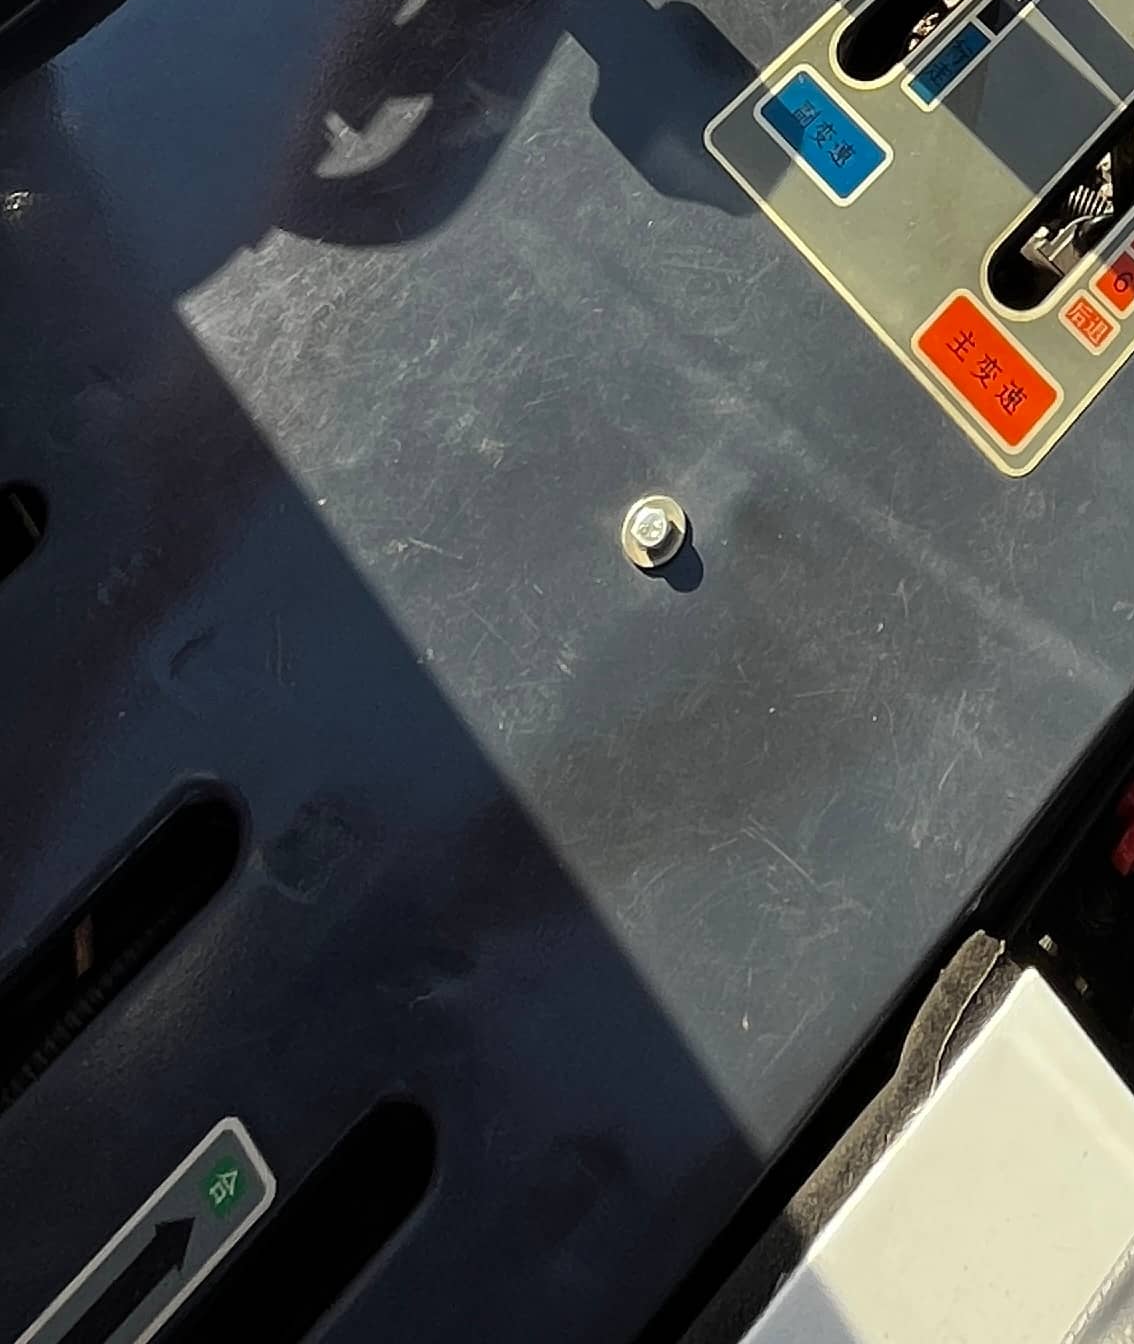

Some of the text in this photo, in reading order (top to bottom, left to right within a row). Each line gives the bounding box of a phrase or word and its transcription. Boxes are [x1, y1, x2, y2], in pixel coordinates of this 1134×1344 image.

[790, 99, 857, 168] 副变速
[1113, 271, 1134, 293] 6
[1066, 299, 1111, 346] 后退
[945, 329, 1028, 416] 主变速
[208, 1168, 239, 1205] 合
